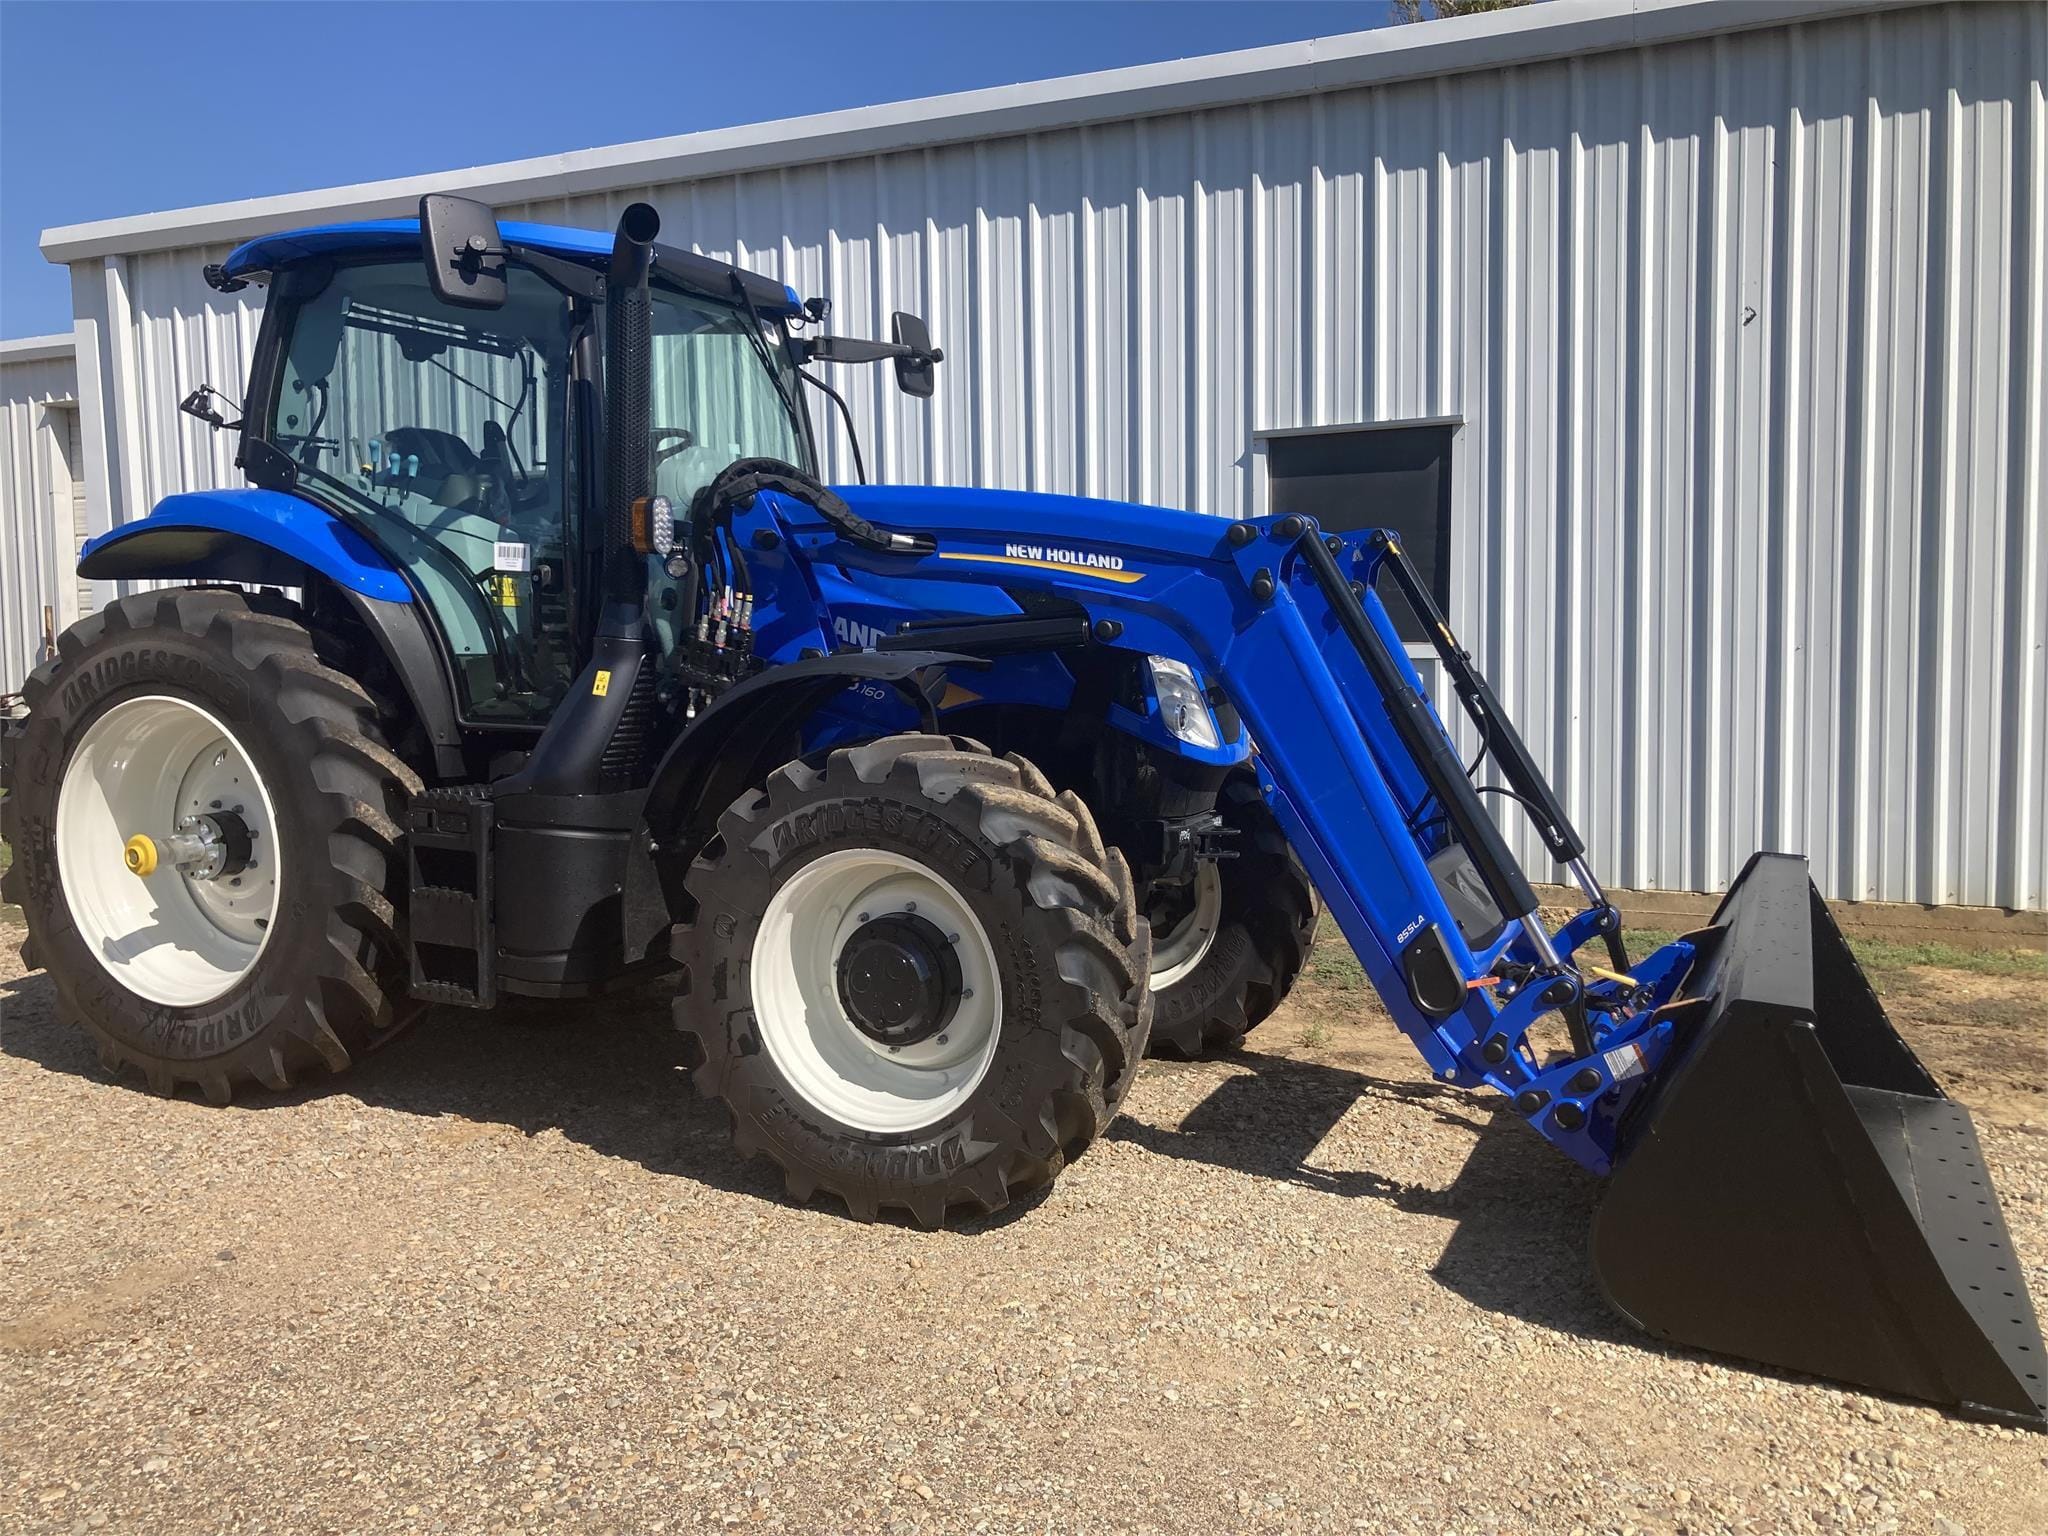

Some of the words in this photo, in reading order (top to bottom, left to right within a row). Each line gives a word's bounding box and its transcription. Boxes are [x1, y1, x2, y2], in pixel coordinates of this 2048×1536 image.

[1006, 543, 1042, 560] NEW
[1046, 548, 1123, 571] HOLLAND
[1397, 914, 1425, 944] 855LA
